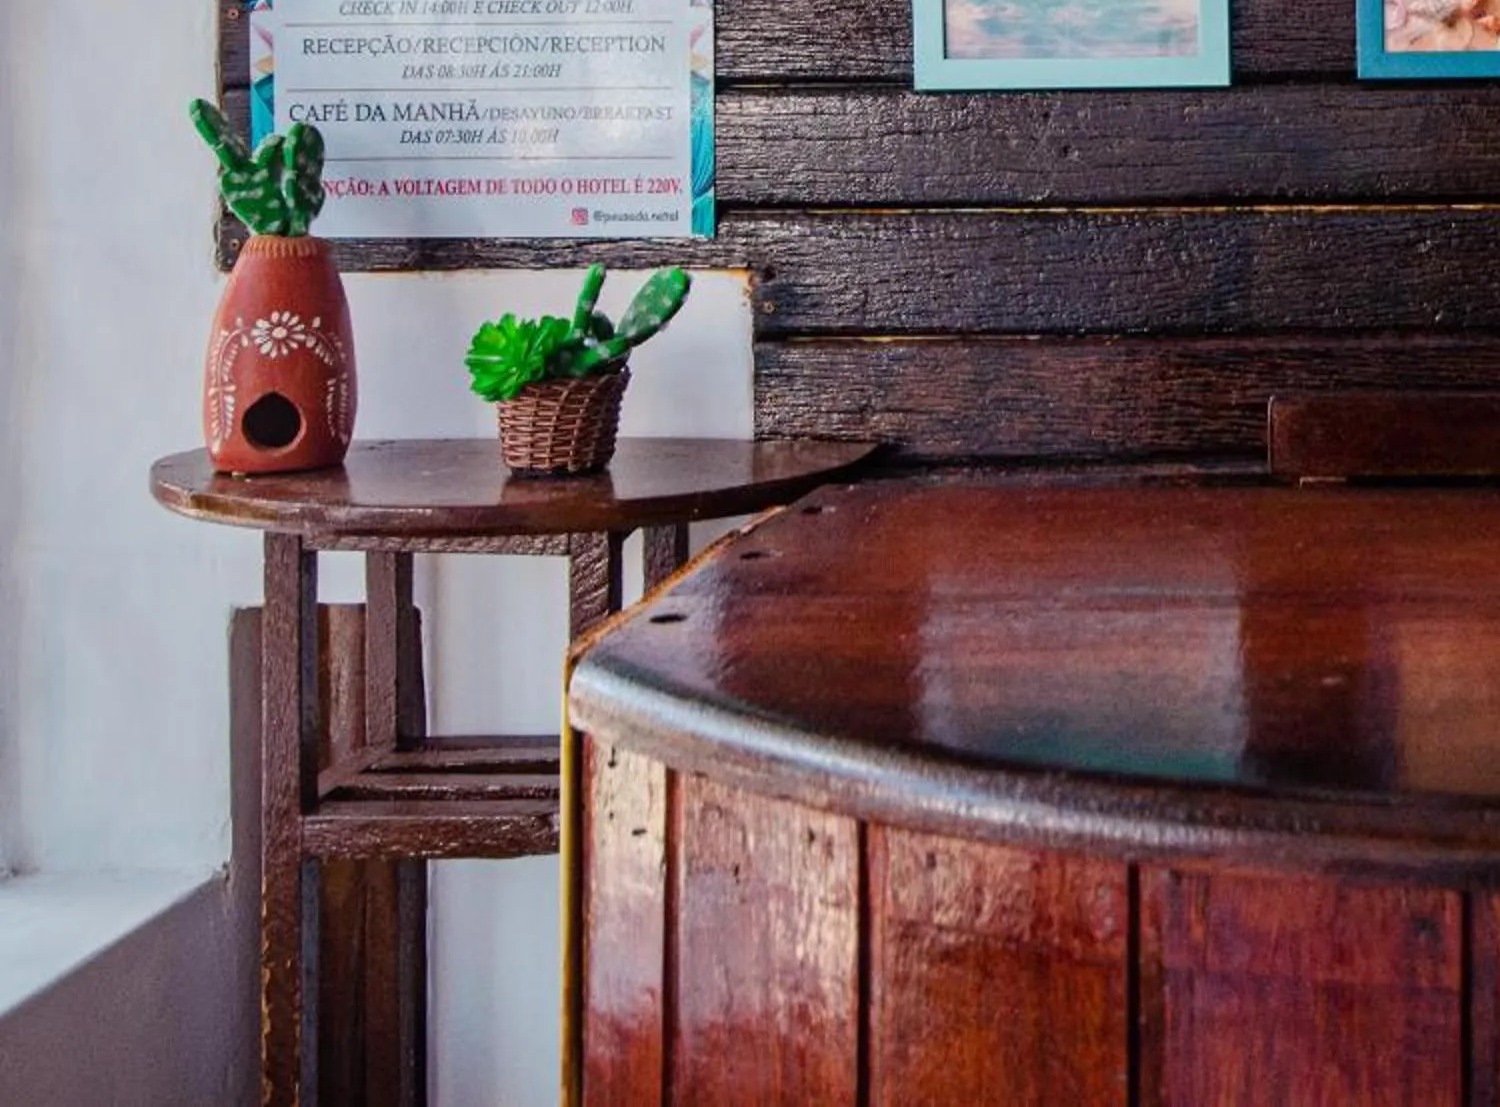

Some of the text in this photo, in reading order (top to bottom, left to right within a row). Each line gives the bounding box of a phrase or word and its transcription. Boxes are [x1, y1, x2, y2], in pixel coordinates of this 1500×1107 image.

[339, 0, 394, 16] CHECK
[400, 0, 418, 15] IN
[473, 0, 485, 14] E
[487, 0, 541, 14] CHECK
[545, 0, 579, 14] OUT
[402, 64, 435, 79] DAS
[289, 99, 349, 122] CAFÉ
[355, 103, 385, 122] DA
[400, 129, 434, 144] DAS
[322, 176, 374, 199] NÇÃO:
[378, 180, 390, 196] A
[393, 179, 481, 196] VOLTAGEM
[486, 179, 507, 195] DE
[511, 179, 557, 194] TODO
[561, 179, 573, 194] O
[577, 178, 630, 194] HOTEL
[634, 174, 643, 193] É
